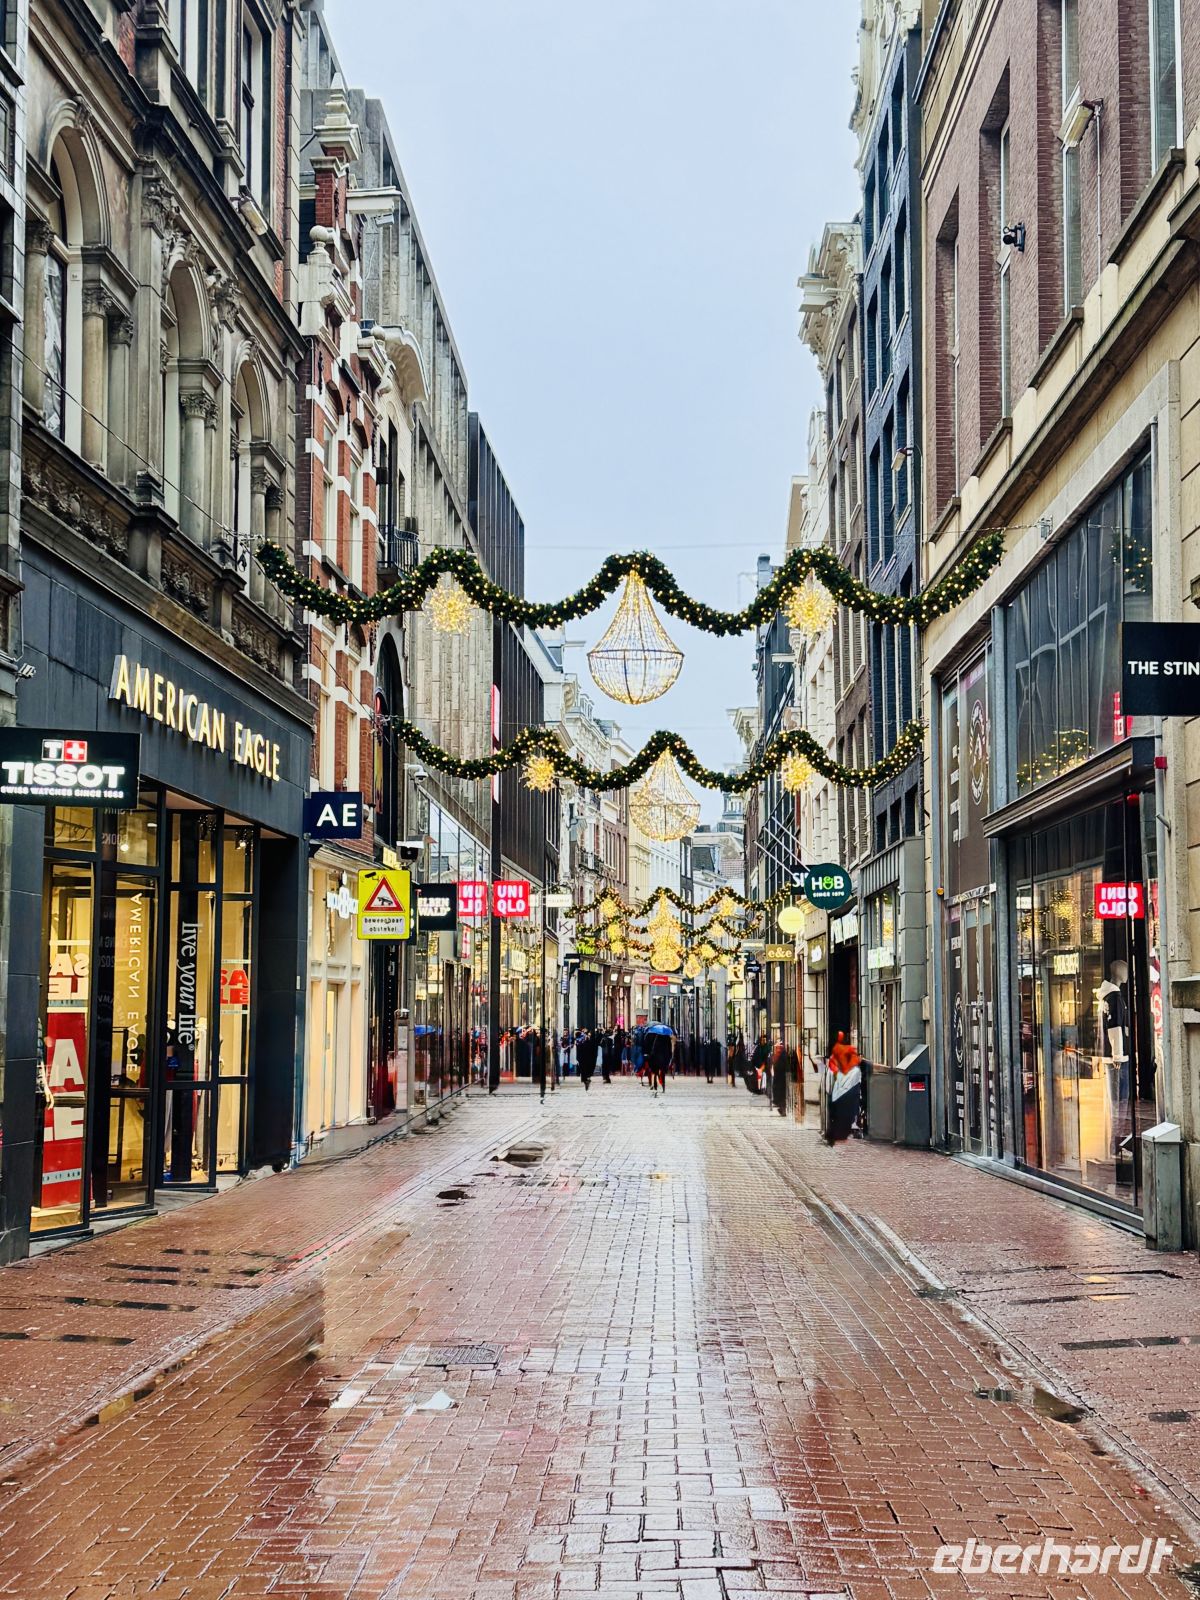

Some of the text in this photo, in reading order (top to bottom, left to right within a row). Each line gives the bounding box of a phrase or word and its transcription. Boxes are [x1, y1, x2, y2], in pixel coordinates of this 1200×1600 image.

[1127, 660, 1200, 676] THE STIN
[109, 655, 280, 782] AMERICAN EAGLE
[1, 761, 125, 788] TISSOT
[0, 786, 29, 795] SWISS
[30, 787, 73, 797] WATCHES
[316, 803, 357, 827] AE
[497, 885, 523, 898] UNI
[497, 899, 526, 915] QLO
[181, 921, 203, 957] live
[177, 959, 196, 1010] your
